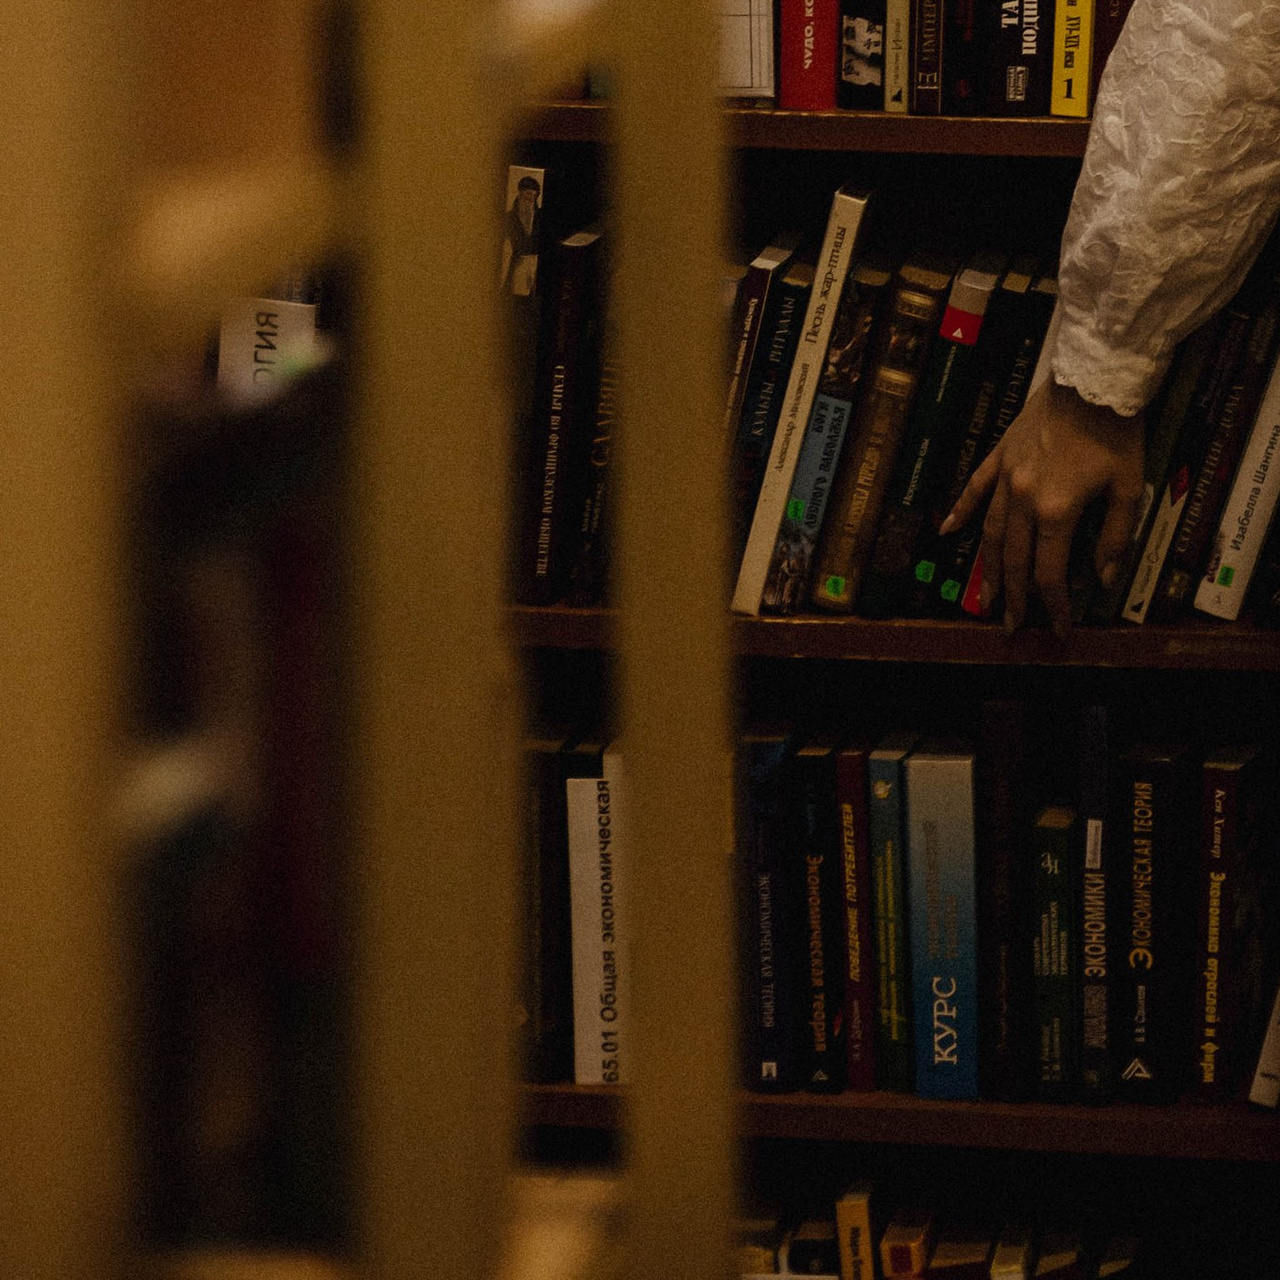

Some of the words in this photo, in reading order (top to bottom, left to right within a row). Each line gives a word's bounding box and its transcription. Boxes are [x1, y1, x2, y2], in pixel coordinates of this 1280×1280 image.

[802, 21, 815, 69] ЧУДО,
[1230, 486, 1262, 551] Изабелла
[596, 780, 616, 944] экономическая
[1084, 872, 1106, 977] ЭКОНОМИКИ
[598, 949, 620, 1022] Общая
[932, 976, 958, 1065] КУРС
